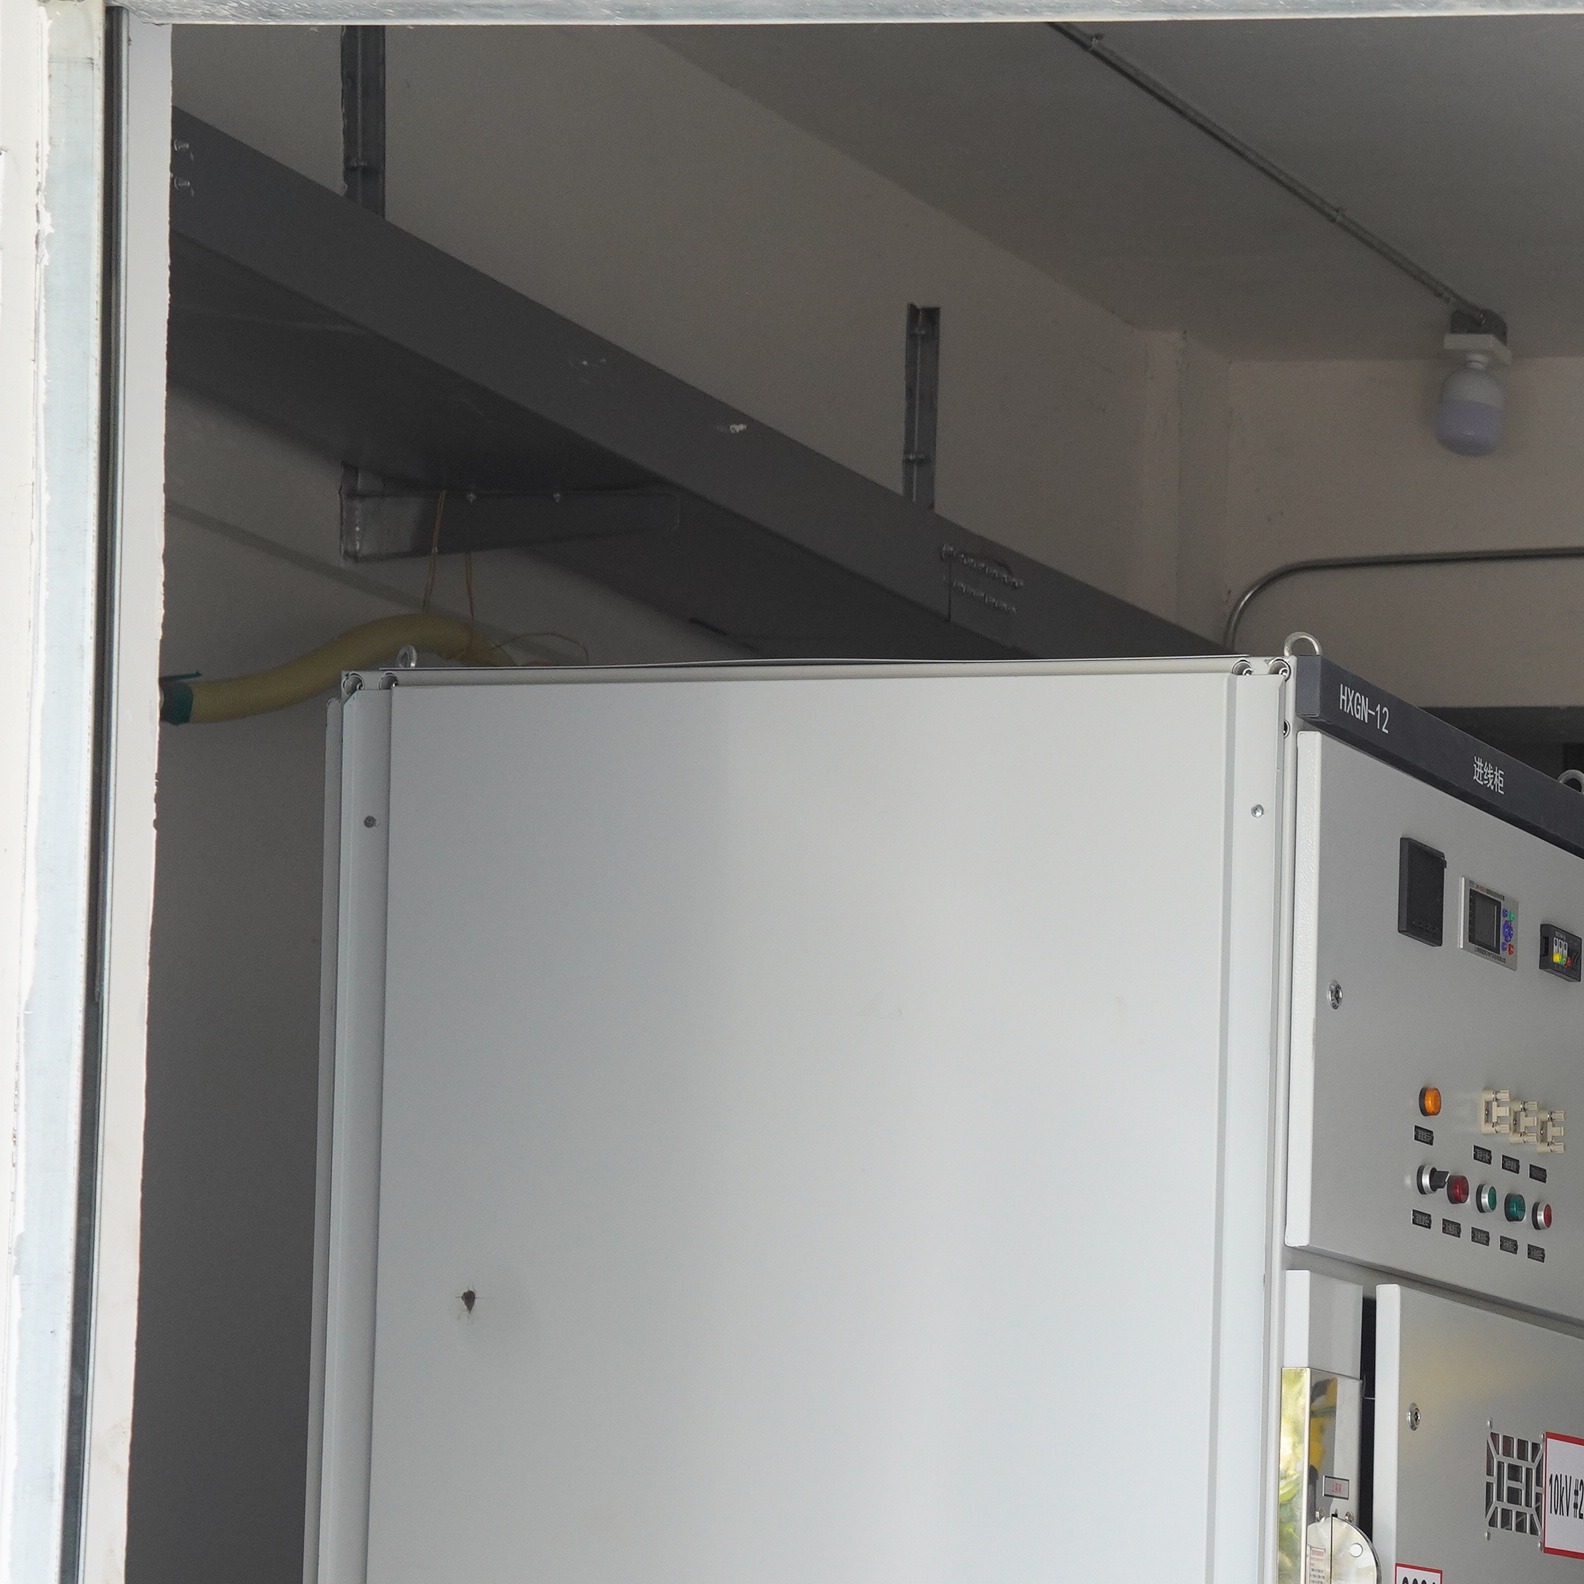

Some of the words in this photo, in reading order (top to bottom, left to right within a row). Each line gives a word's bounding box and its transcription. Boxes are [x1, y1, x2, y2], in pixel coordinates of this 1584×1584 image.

[1339, 683, 1389, 734] HXGN-12
[1472, 755, 1505, 795] 进线柜
[1549, 1473, 1572, 1517] 10kV
